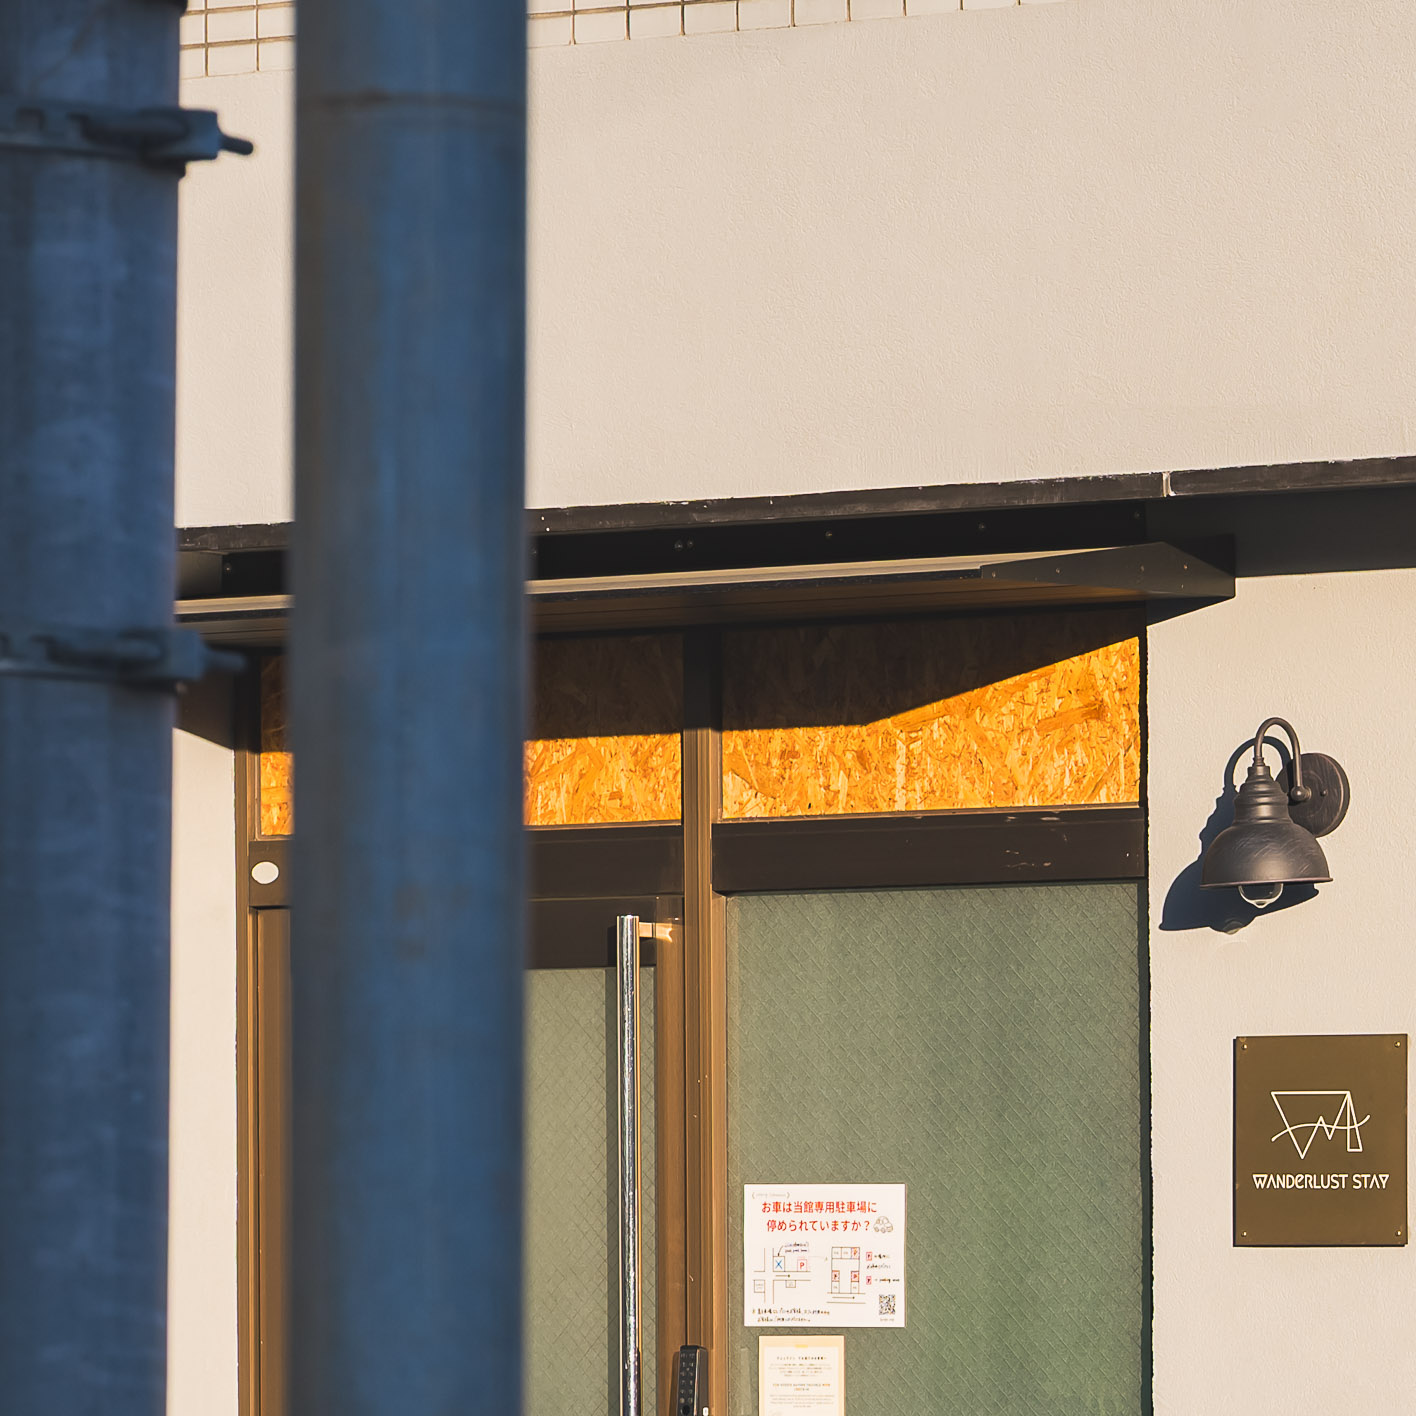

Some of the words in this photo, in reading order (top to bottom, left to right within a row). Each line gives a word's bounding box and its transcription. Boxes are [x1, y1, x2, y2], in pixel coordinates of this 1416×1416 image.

[1252, 1174, 1349, 1189] WANDERLUST
[1352, 1174, 1390, 1189] STAY
[761, 1201, 877, 1214] お車は当館専用駐車場に
